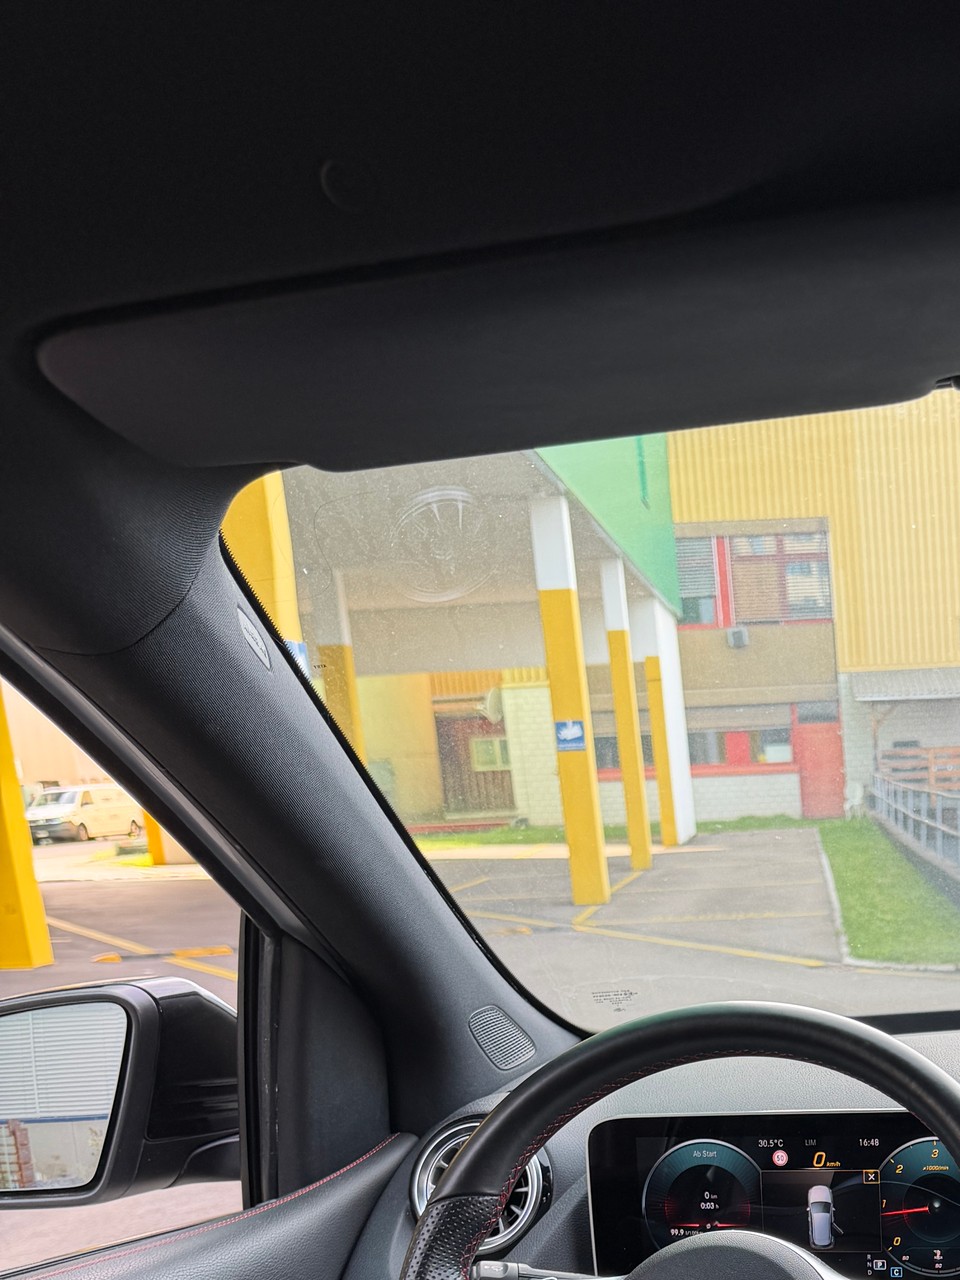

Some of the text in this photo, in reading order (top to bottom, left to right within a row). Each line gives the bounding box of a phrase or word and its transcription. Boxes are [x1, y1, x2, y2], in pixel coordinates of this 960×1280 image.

[758, 1139, 784, 1147] 30.5°C
[859, 1138, 880, 1146] 16:48
[693, 1150, 717, 1158] Ab Start
[931, 1149, 939, 1158] 3
[813, 1151, 826, 1167] 0
[896, 1164, 904, 1174] 2
[704, 1191, 710, 1199] 0
[700, 1202, 715, 1210] 0:03
[882, 1199, 887, 1208] 1
[893, 1237, 901, 1246] 0
